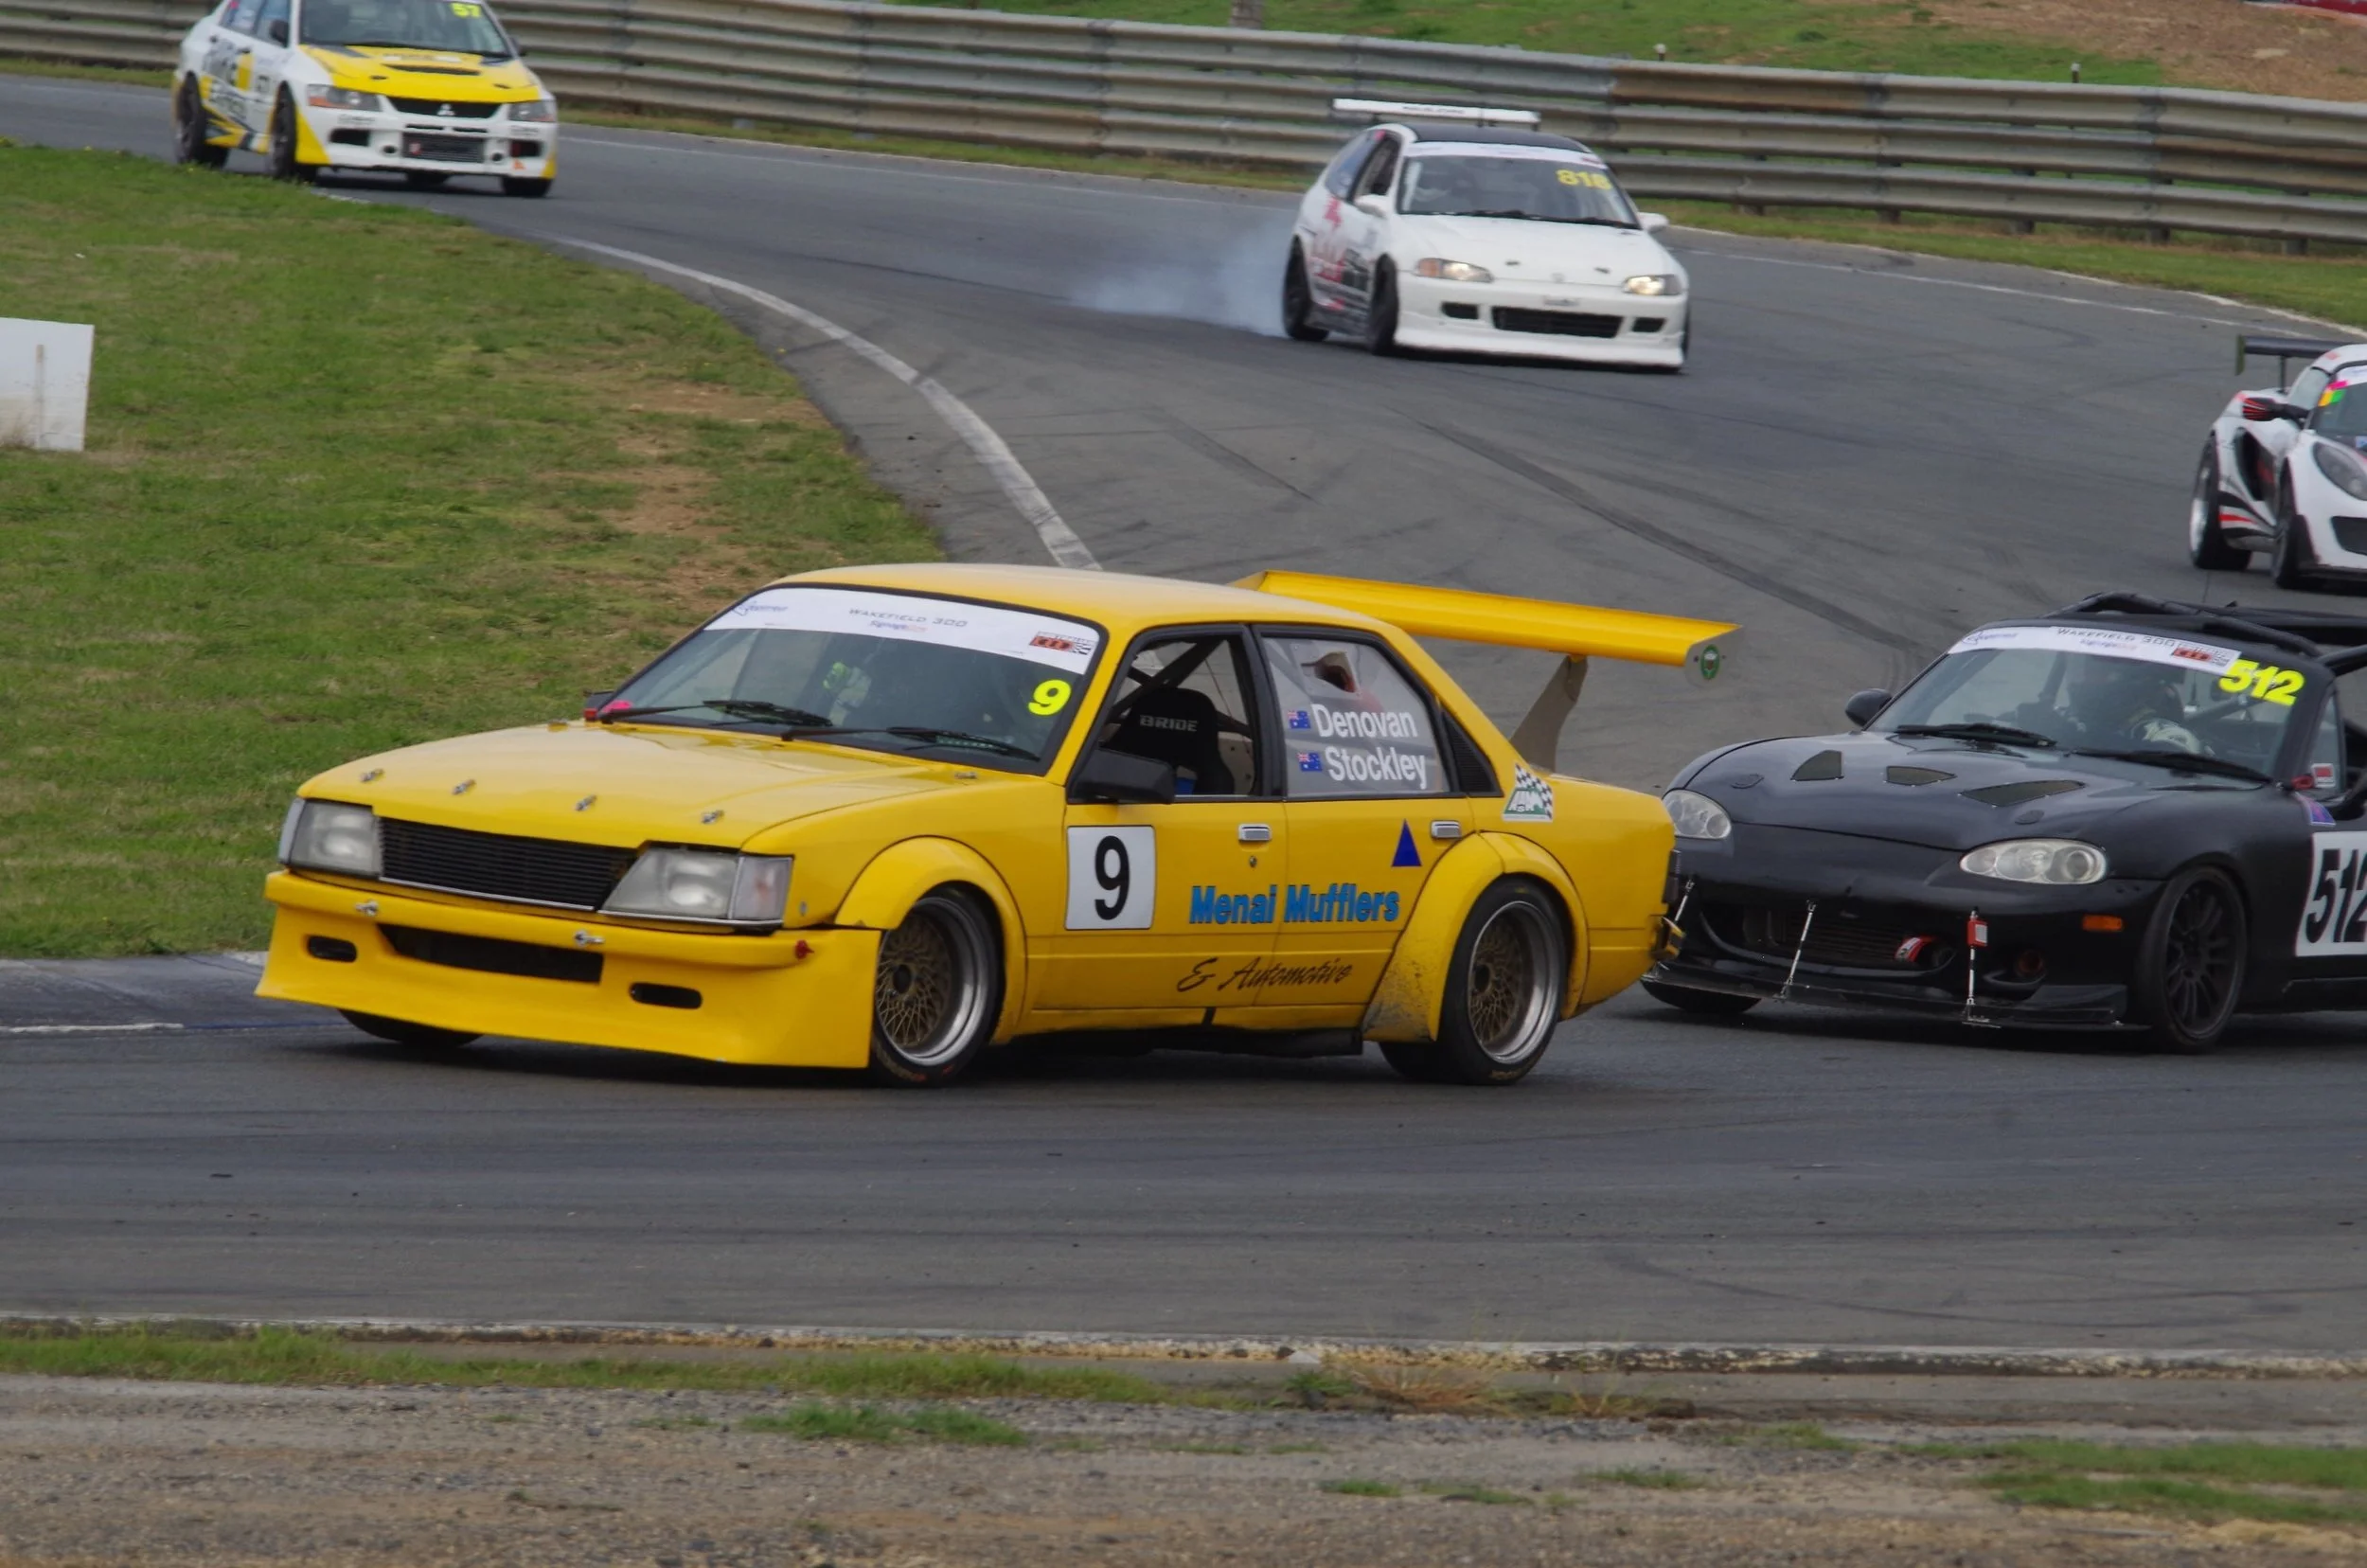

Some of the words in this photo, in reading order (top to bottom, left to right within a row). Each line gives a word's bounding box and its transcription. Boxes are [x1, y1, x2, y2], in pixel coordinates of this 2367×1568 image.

[849, 608, 928, 623] WAKEFIELD
[932, 616, 969, 628] 300
[2056, 627, 2136, 643] WAKEFIELD
[2143, 633, 2175, 648] 300
[1028, 679, 1072, 716] 9
[2218, 658, 2305, 706] 512
[1139, 714, 1200, 733] BRIDE
[1309, 703, 1419, 739] Denovan
[1325, 745, 1428, 791] Stockley
[1095, 835, 1130, 920] 9
[1188, 884, 1278, 925] Menai
[1283, 882, 1400, 923] Mufflers
[1217, 955, 1354, 991] Automotive
